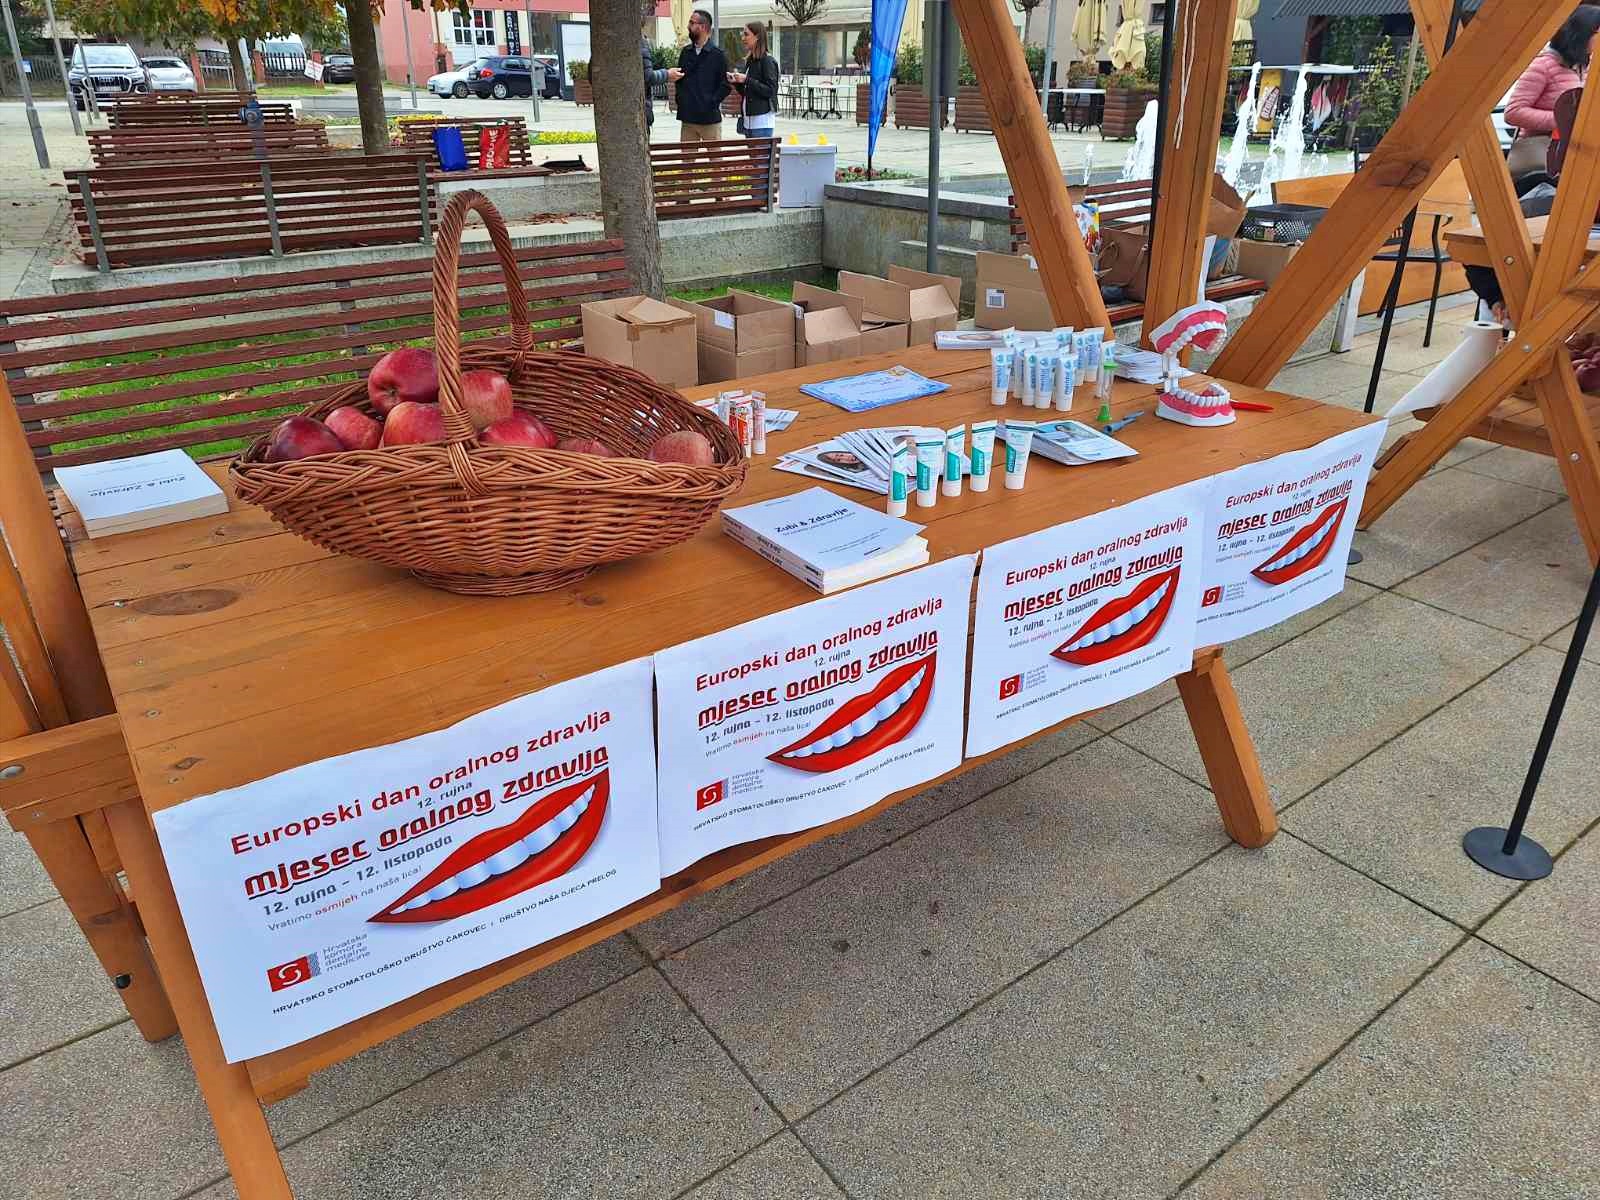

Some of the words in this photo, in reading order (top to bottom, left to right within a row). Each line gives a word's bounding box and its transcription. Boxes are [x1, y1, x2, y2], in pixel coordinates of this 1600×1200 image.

[775, 522, 798, 534] Zubi
[808, 506, 849, 525] Zdravlje
[1217, 513, 1268, 540] mjesec
[1225, 484, 1274, 509] Europski
[1004, 588, 1063, 622] mjesec
[1067, 566, 1122, 601] oralnog
[1126, 546, 1183, 579] zdravlja
[1006, 556, 1067, 586] Europski
[1071, 550, 1094, 566] dan
[1097, 533, 1142, 556] oralnog
[1144, 516, 1188, 540] zdravlja
[696, 652, 778, 691] Europski
[785, 644, 817, 663] dan
[822, 620, 882, 650] oralnog
[886, 598, 942, 628] zdravlja
[814, 656, 826, 668] 12.
[698, 687, 777, 730] mjesec
[785, 660, 862, 702] oralnog
[868, 631, 938, 673] zdravlja
[705, 731, 720, 744] 12.
[723, 720, 751, 736] rujna
[766, 712, 782, 723] 12.
[785, 698, 834, 719] listopada
[231, 800, 362, 854] Europski
[371, 785, 420, 811] dan
[429, 745, 519, 790] oralnog
[527, 711, 610, 752] zdravlja
[417, 797, 436, 809] 12.
[440, 781, 473, 801] rujna
[245, 840, 368, 899] mjesec
[380, 790, 495, 851] oralnog
[503, 747, 608, 803] zdravlja
[263, 901, 289, 916] 12.
[294, 884, 337, 906] rujna
[356, 866, 379, 881] 12.
[384, 835, 452, 870] listopada
